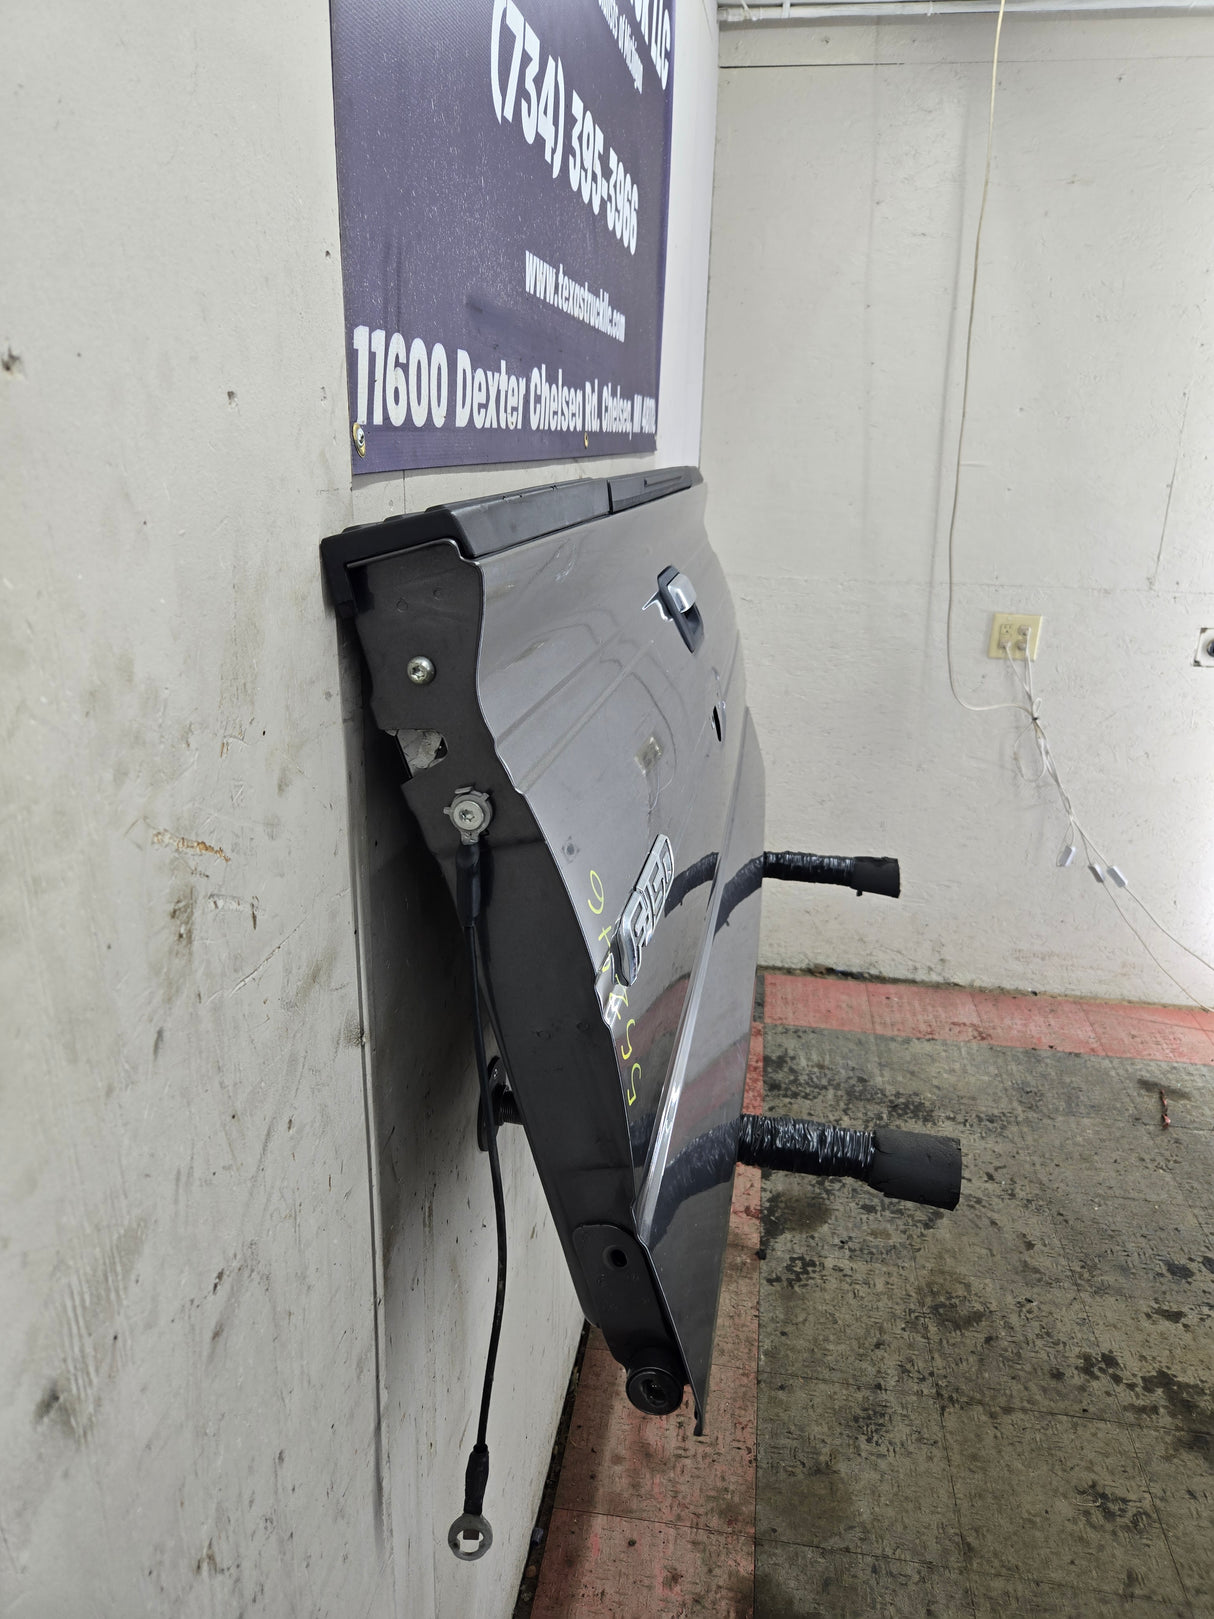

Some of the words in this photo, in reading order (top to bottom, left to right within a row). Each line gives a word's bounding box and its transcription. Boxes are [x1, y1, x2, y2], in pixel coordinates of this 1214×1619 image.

[491, 0, 565, 179] (734)
[569, 90, 639, 255] 395-3966
[525, 250, 626, 343] www.texastruckllc.com
[353, 325, 448, 428] 11600
[456, 349, 526, 430] Dexter
[530, 364, 583, 432] Chelsea
[585, 378, 600, 433] Rd.
[602, 382, 632, 440] Chelsea,
